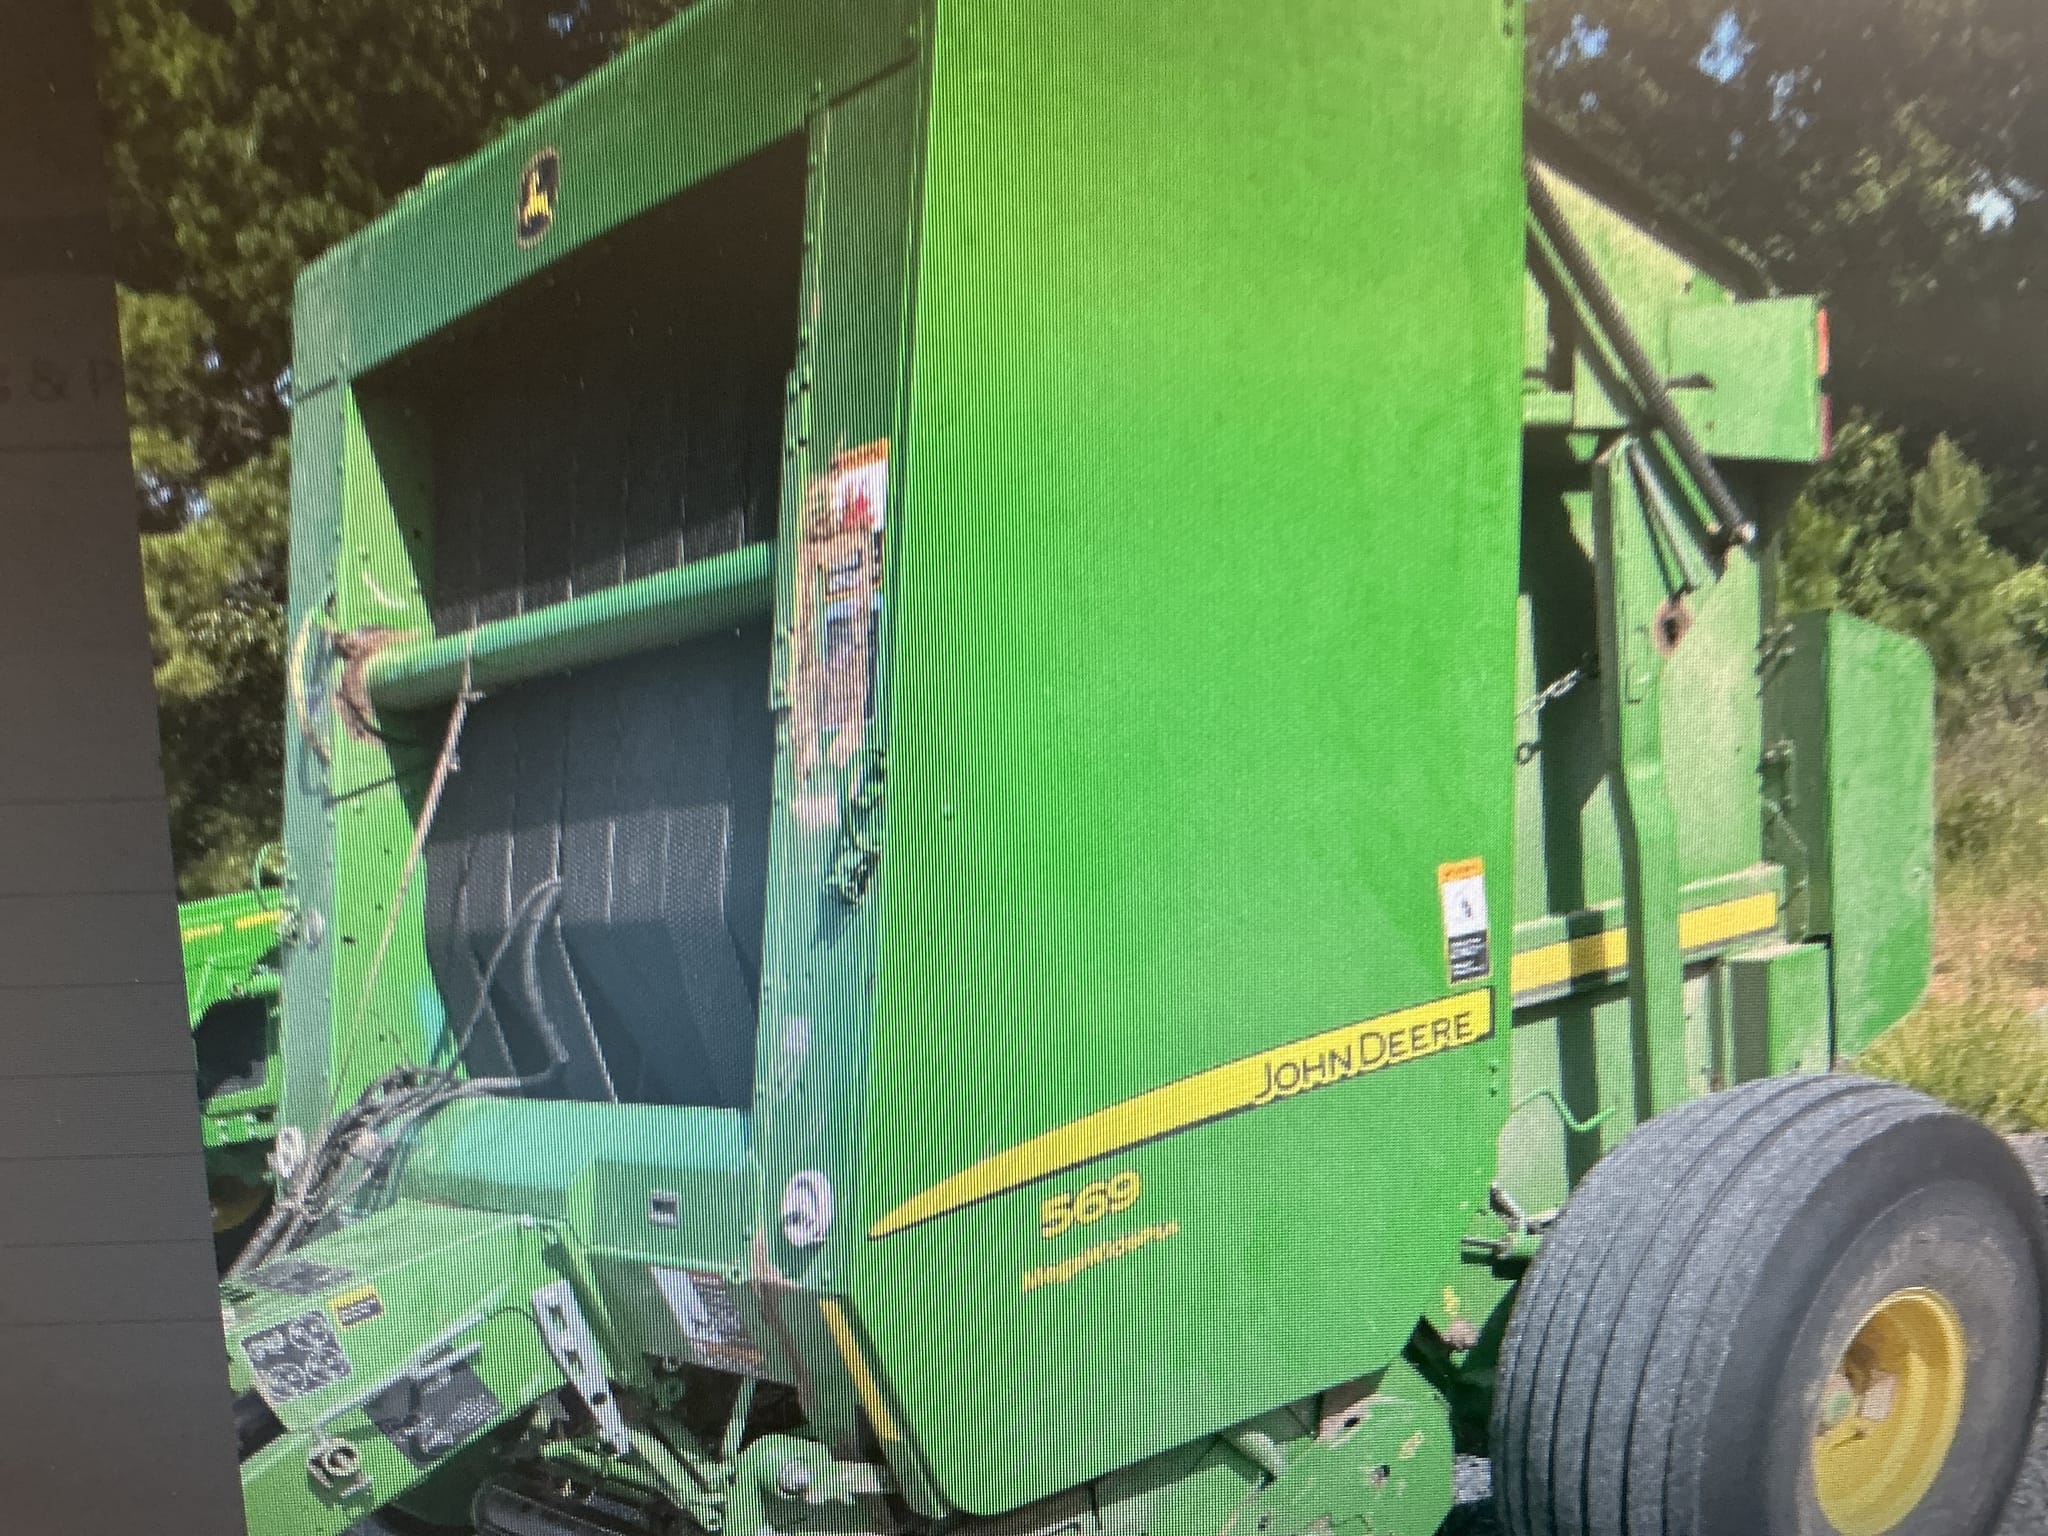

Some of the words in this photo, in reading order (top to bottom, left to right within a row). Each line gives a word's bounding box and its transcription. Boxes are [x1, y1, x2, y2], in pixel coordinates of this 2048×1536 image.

[1255, 1044, 1352, 1099] JOHN
[1359, 1010, 1473, 1065] DEERE
[1040, 1170, 1142, 1241] 569
